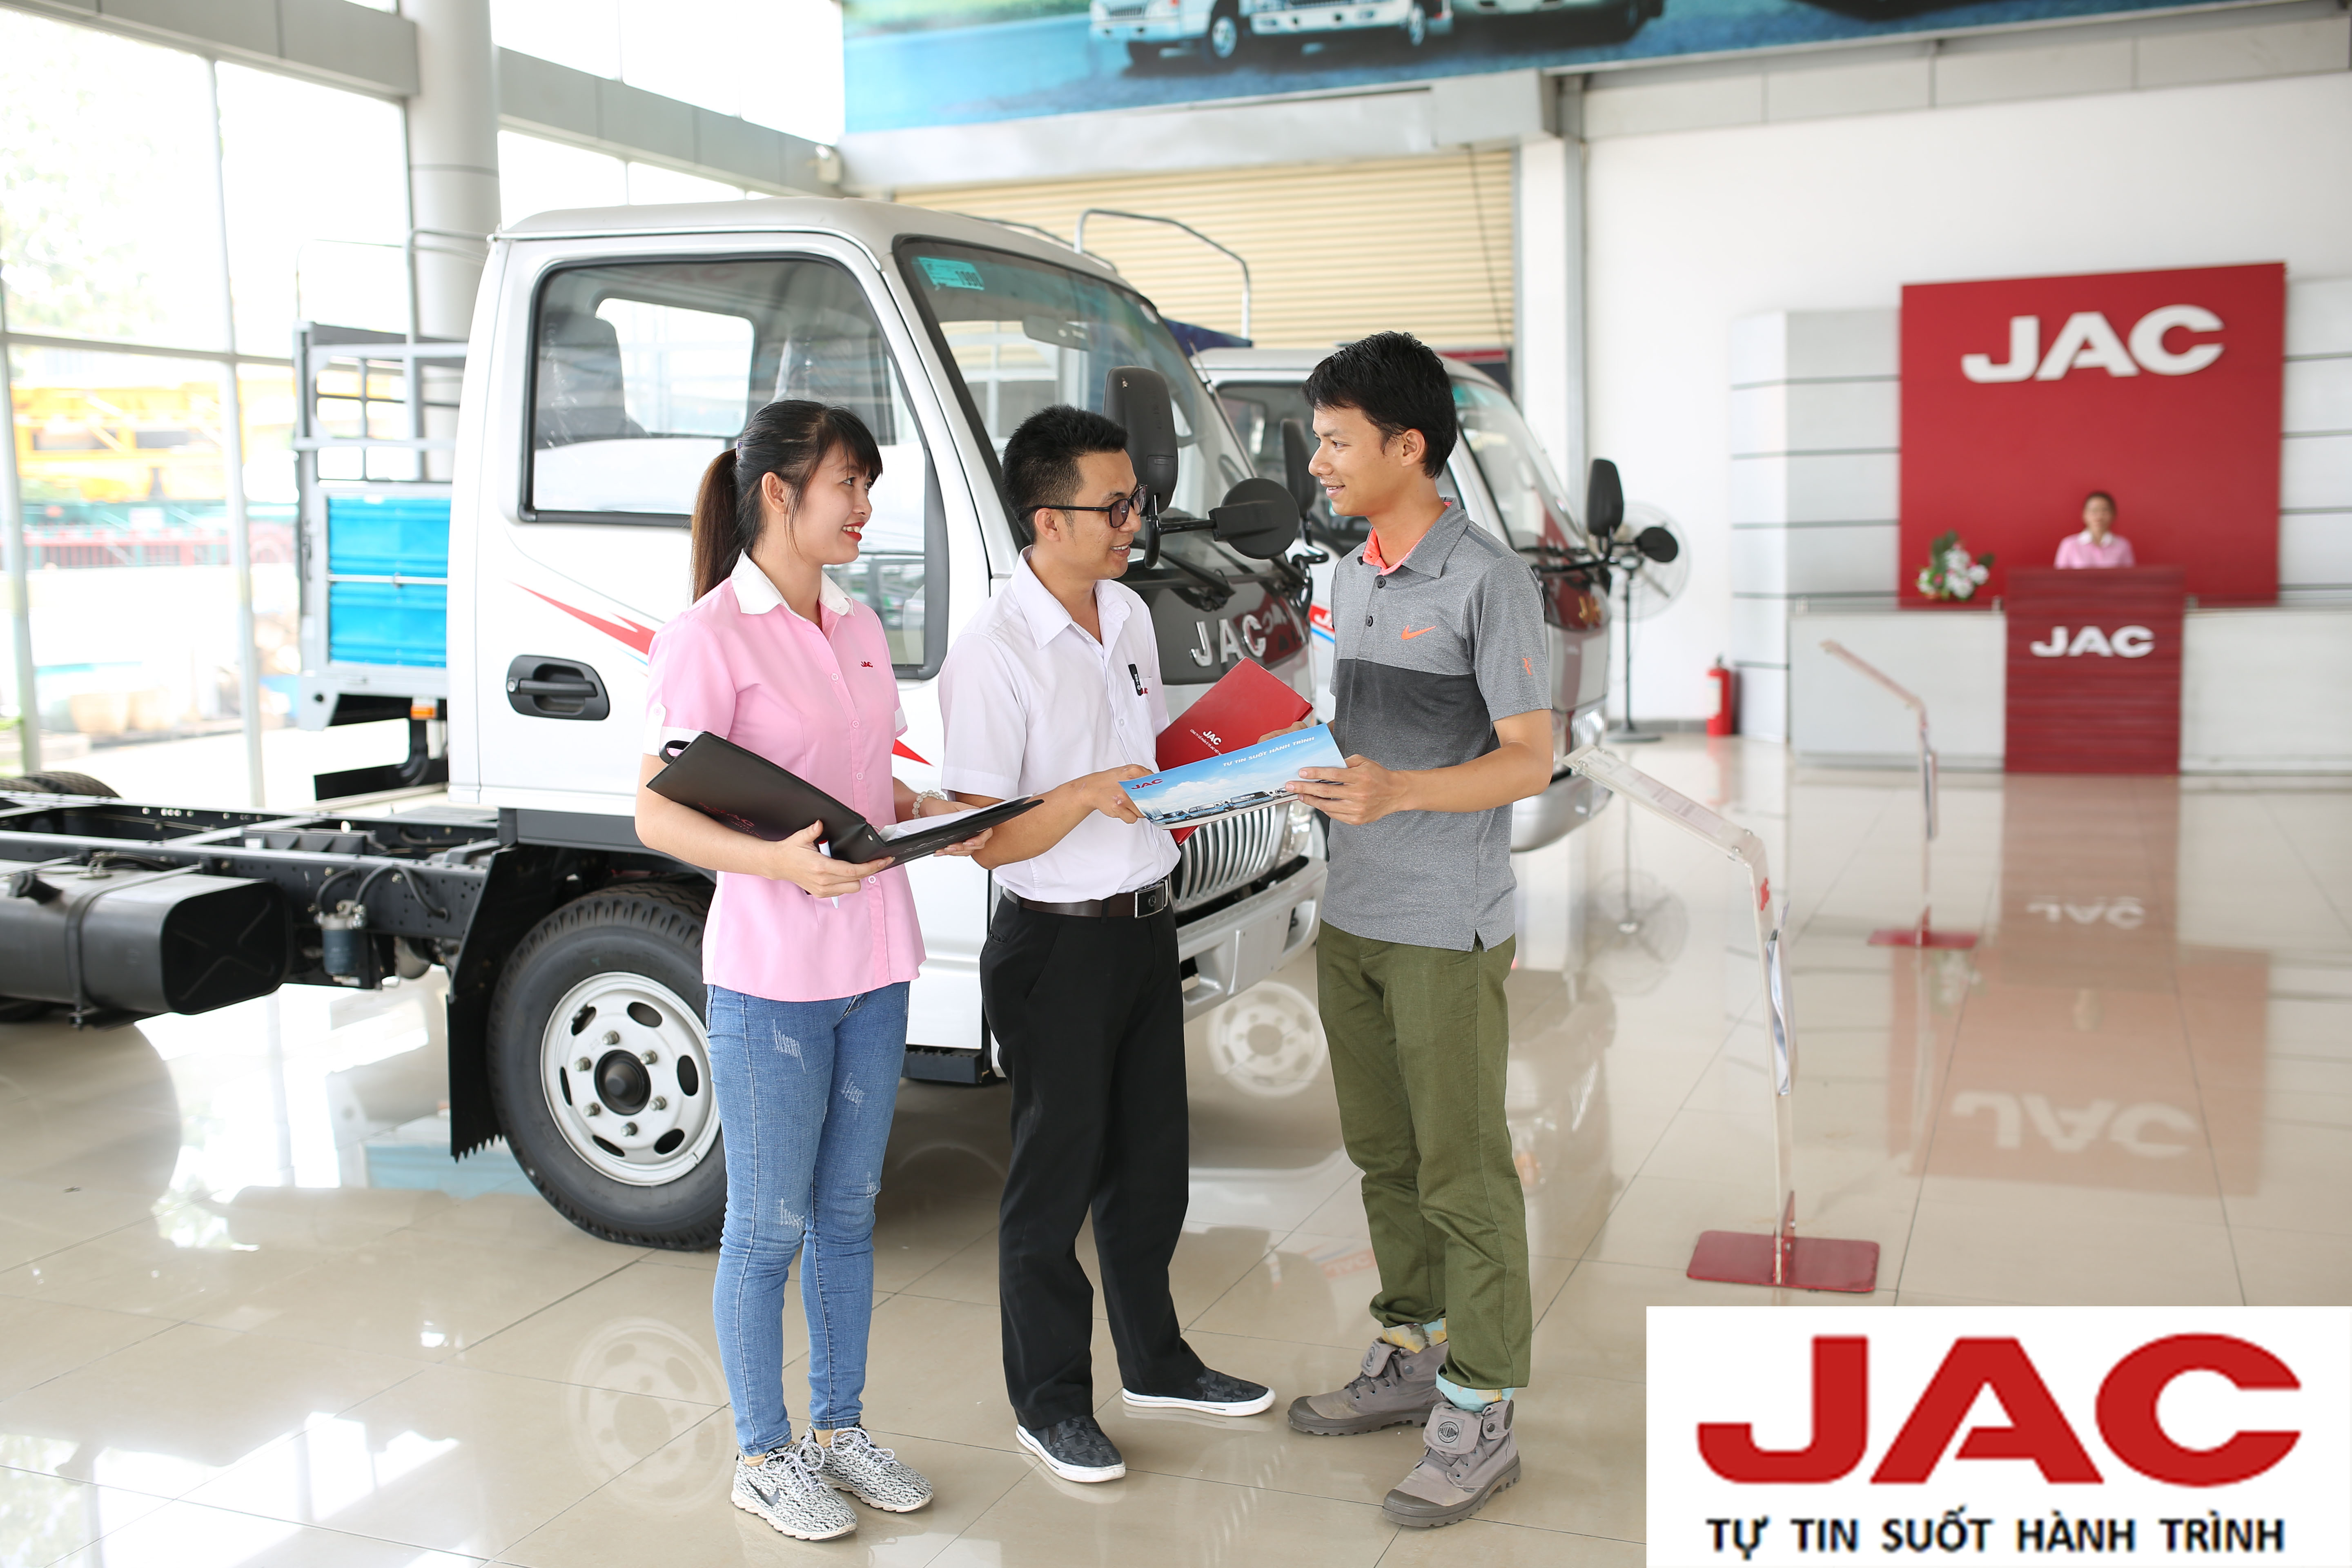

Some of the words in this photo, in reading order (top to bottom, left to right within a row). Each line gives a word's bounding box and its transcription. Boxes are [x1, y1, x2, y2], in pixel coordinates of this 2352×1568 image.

[1962, 304, 2224, 383] JAC
[1190, 614, 1266, 667] JAC
[2030, 625, 2154, 658] JAC
[1203, 731, 1222, 745] JAC
[1269, 744, 1290, 754] HÀNH
[1292, 737, 1315, 746] TRÌNH
[1131, 779, 1163, 789] JAC
